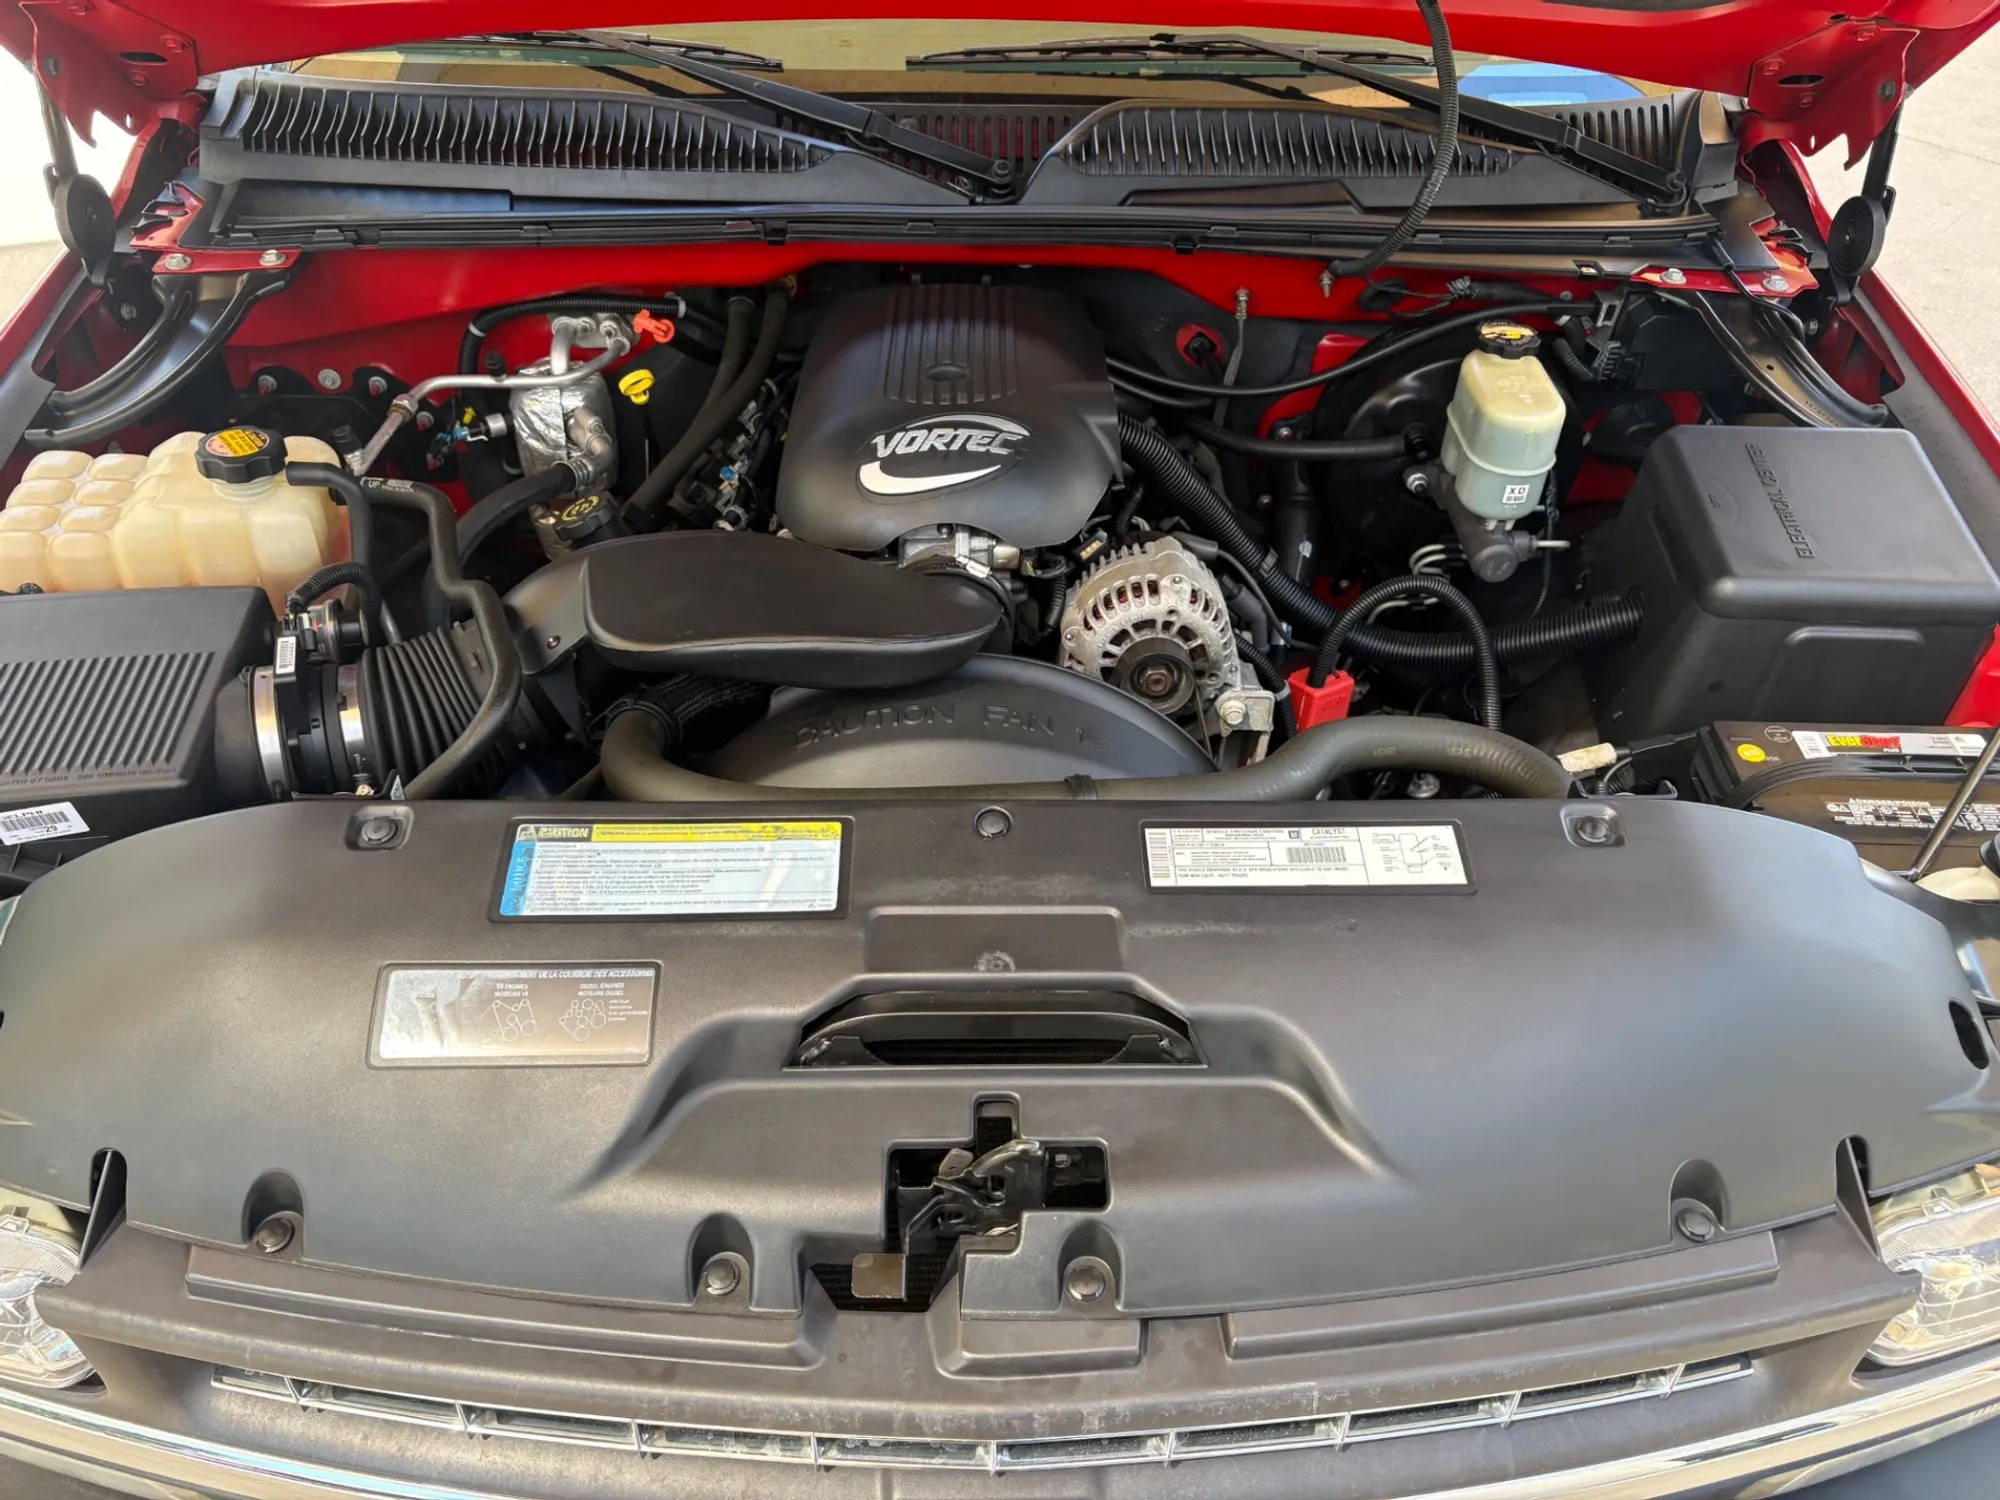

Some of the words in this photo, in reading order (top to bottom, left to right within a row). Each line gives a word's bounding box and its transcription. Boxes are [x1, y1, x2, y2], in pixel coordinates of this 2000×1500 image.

[871, 427, 1025, 459] VORTEC
[368, 480, 381, 488] UP
[1767, 488, 1816, 559] ELECTRICAL
[793, 703, 954, 748] CAUTION
[983, 705, 1055, 736] FAN
[539, 827, 589, 838] CAUTION
